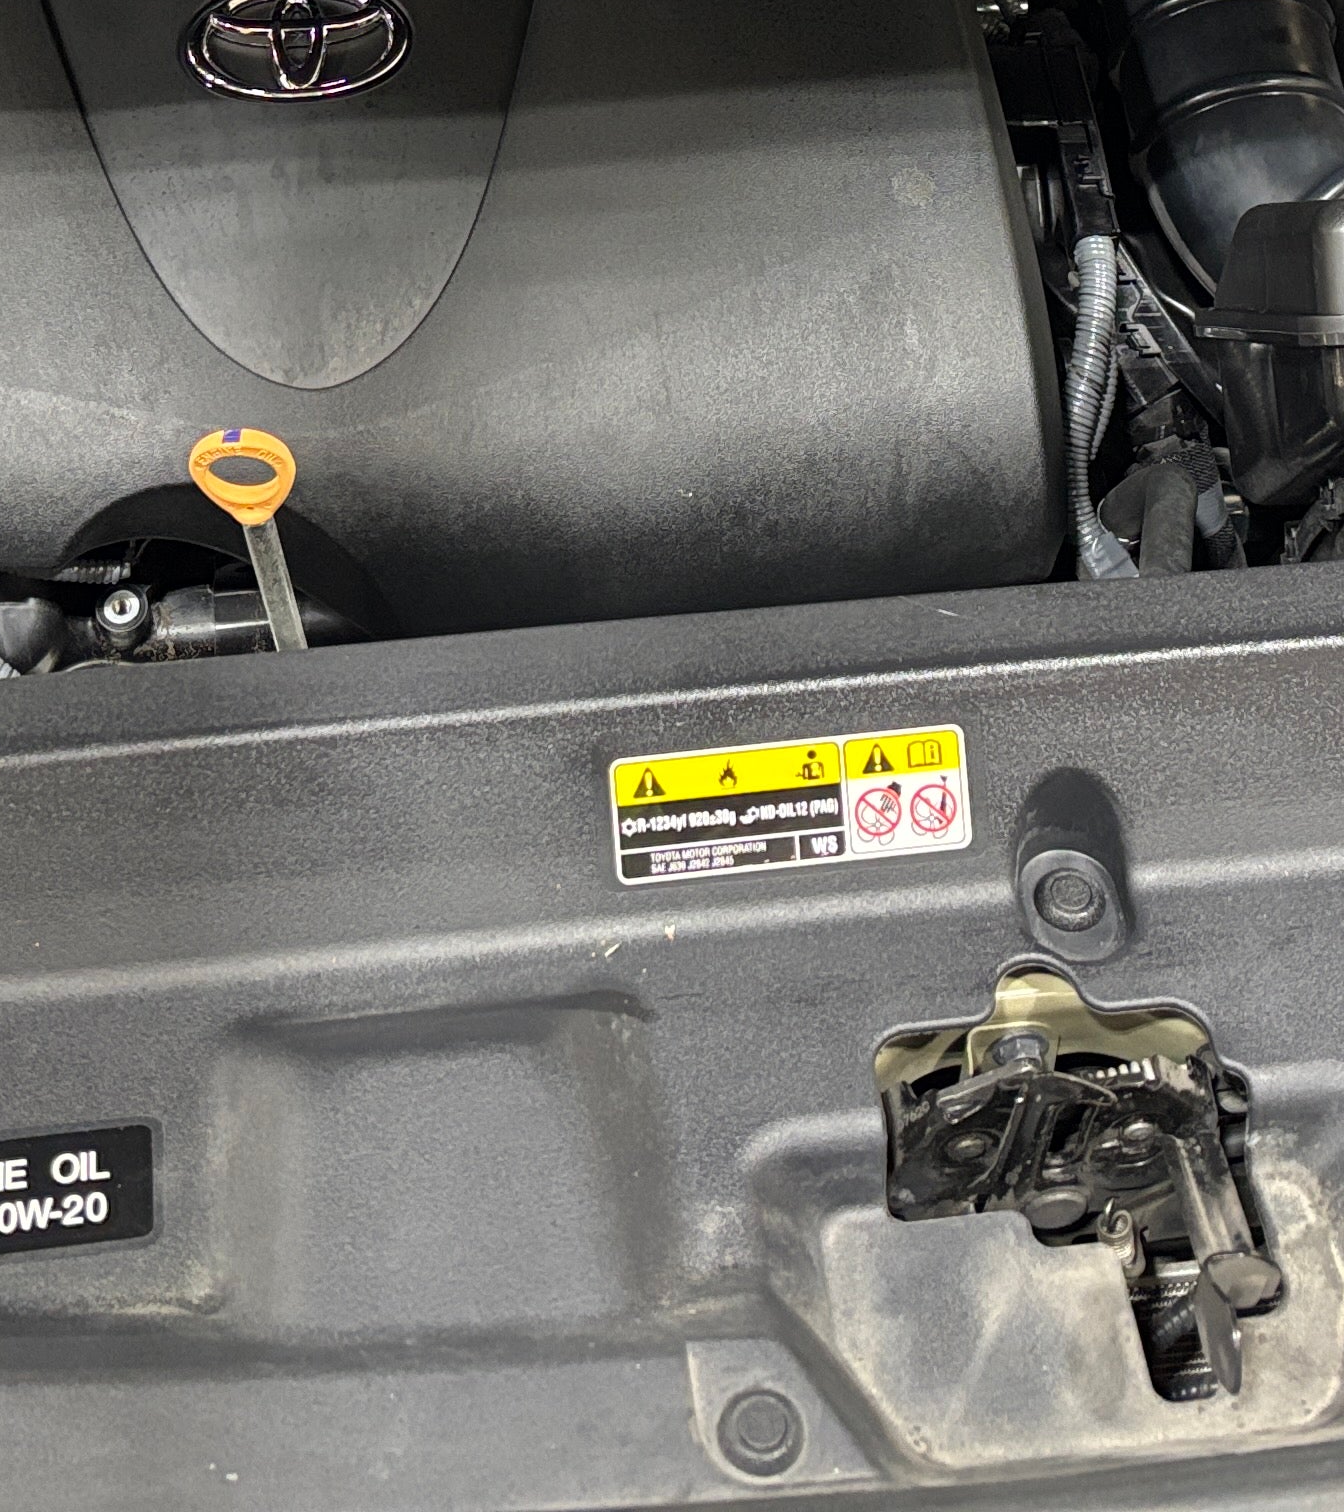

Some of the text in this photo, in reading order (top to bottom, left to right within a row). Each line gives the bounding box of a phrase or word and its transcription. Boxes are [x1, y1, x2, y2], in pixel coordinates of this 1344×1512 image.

[637, 813, 687, 833] R-1234yf
[809, 797, 839, 817] (PAG)
[650, 841, 767, 863] TOYOTA MOTOR CORPORATION
[811, 835, 839, 855] WS
[50, 1150, 111, 1186] OIL
